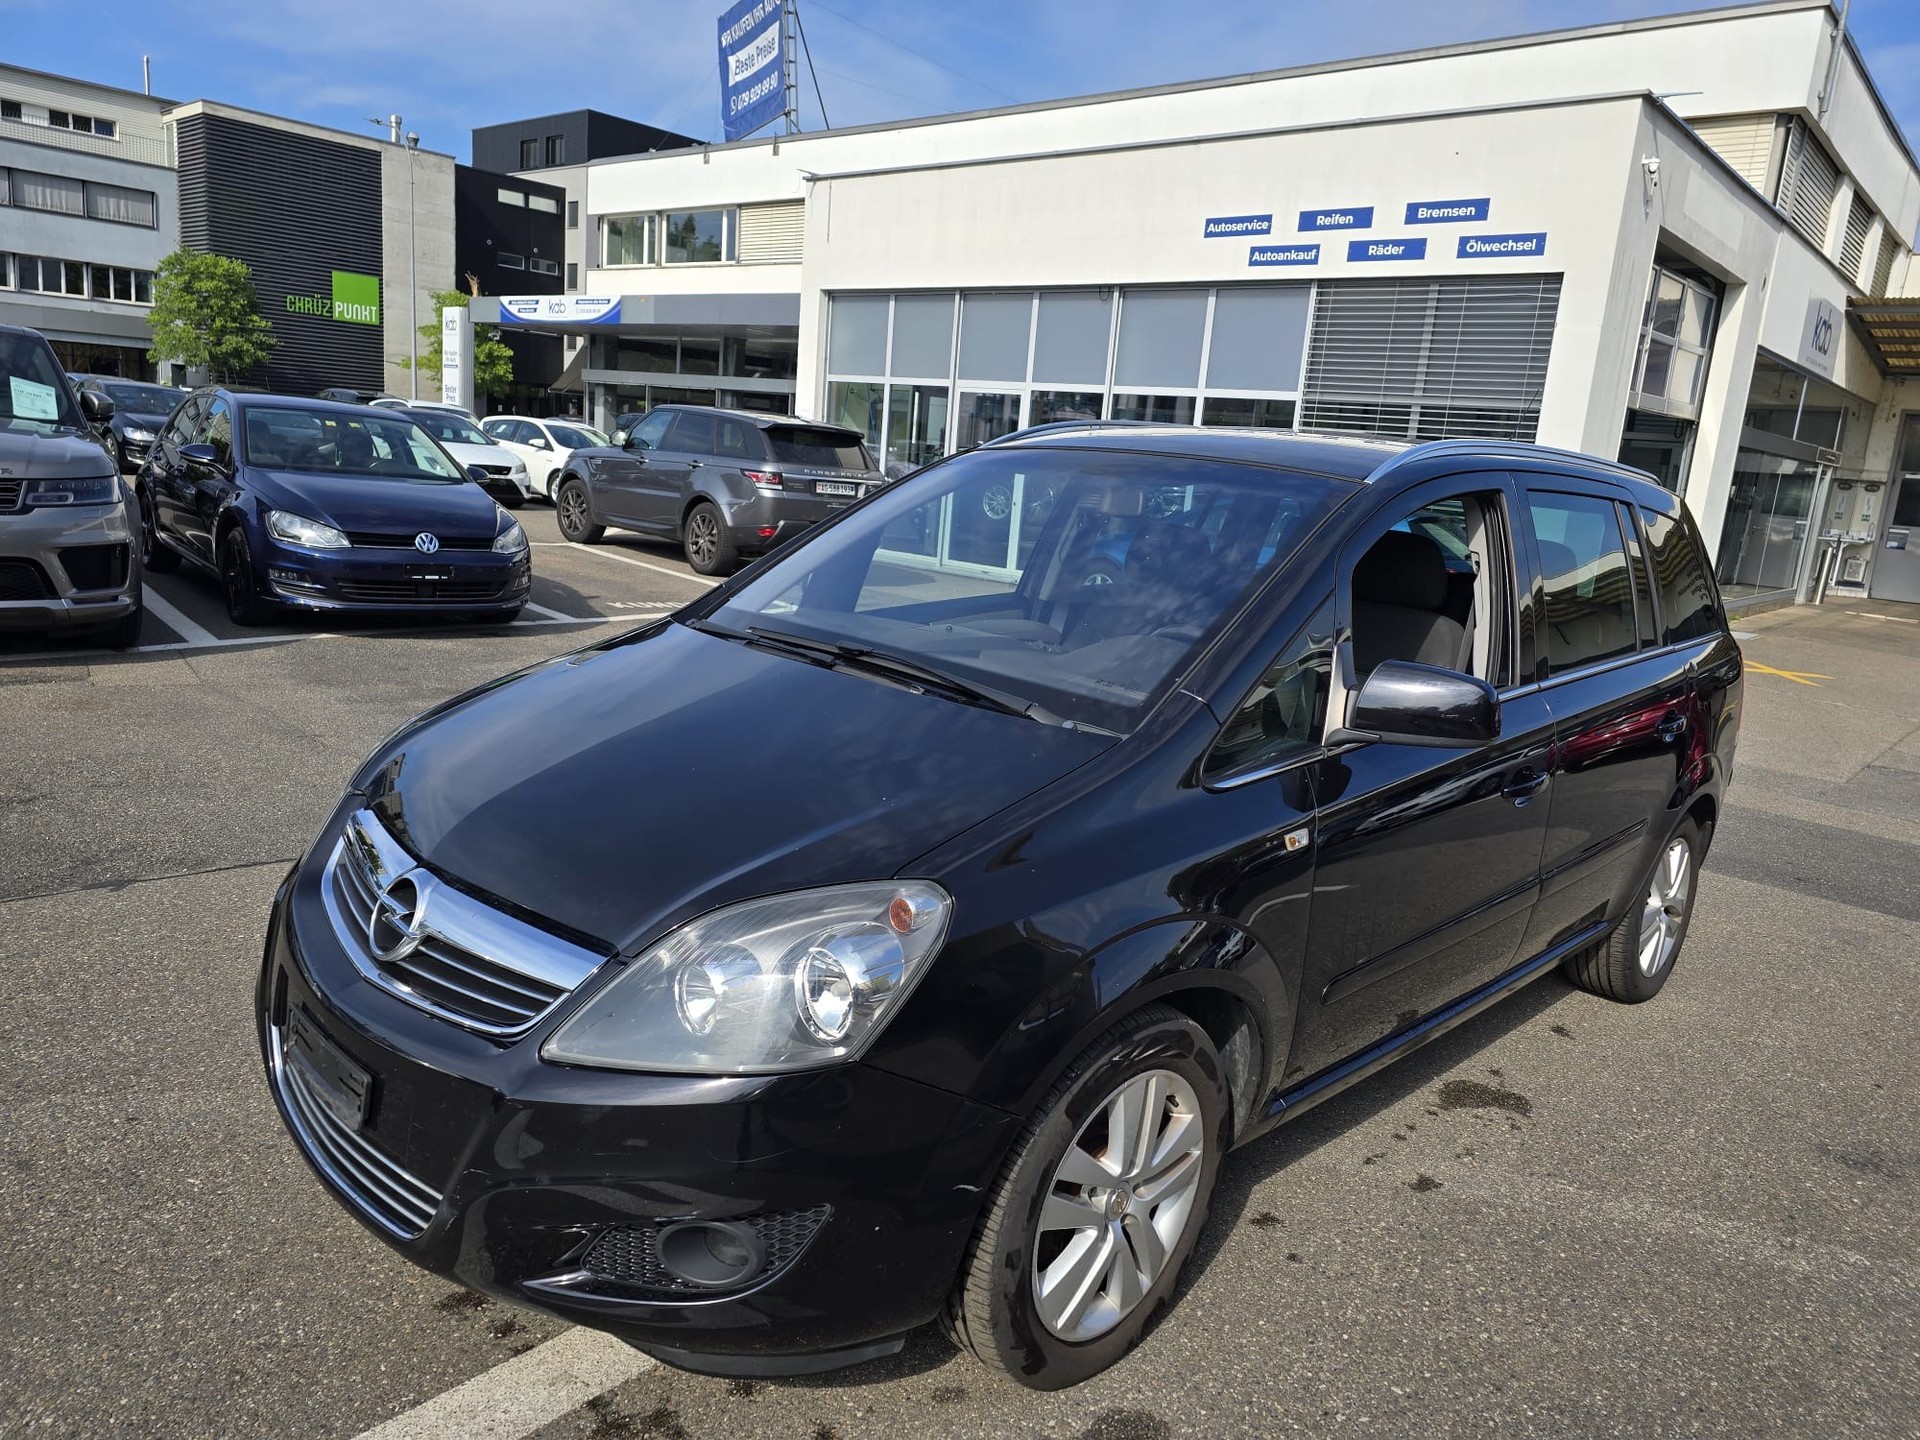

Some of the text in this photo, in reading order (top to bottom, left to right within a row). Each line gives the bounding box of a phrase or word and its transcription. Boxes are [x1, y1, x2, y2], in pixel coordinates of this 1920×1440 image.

[734, 37, 776, 76] Beste Preise
[1417, 204, 1476, 219] Bremsen
[1206, 219, 1269, 233] Autoservice
[1316, 213, 1354, 226] Reifen
[1367, 243, 1405, 256] Räder
[1465, 238, 1537, 253] Ölwechsel
[1251, 249, 1317, 262] Autoankauf
[286, 293, 377, 322] CHRÜZ PUNKT
[548, 299, 567, 315] kab
[1811, 300, 1832, 356] kab
[415, 532, 439, 554] VW
